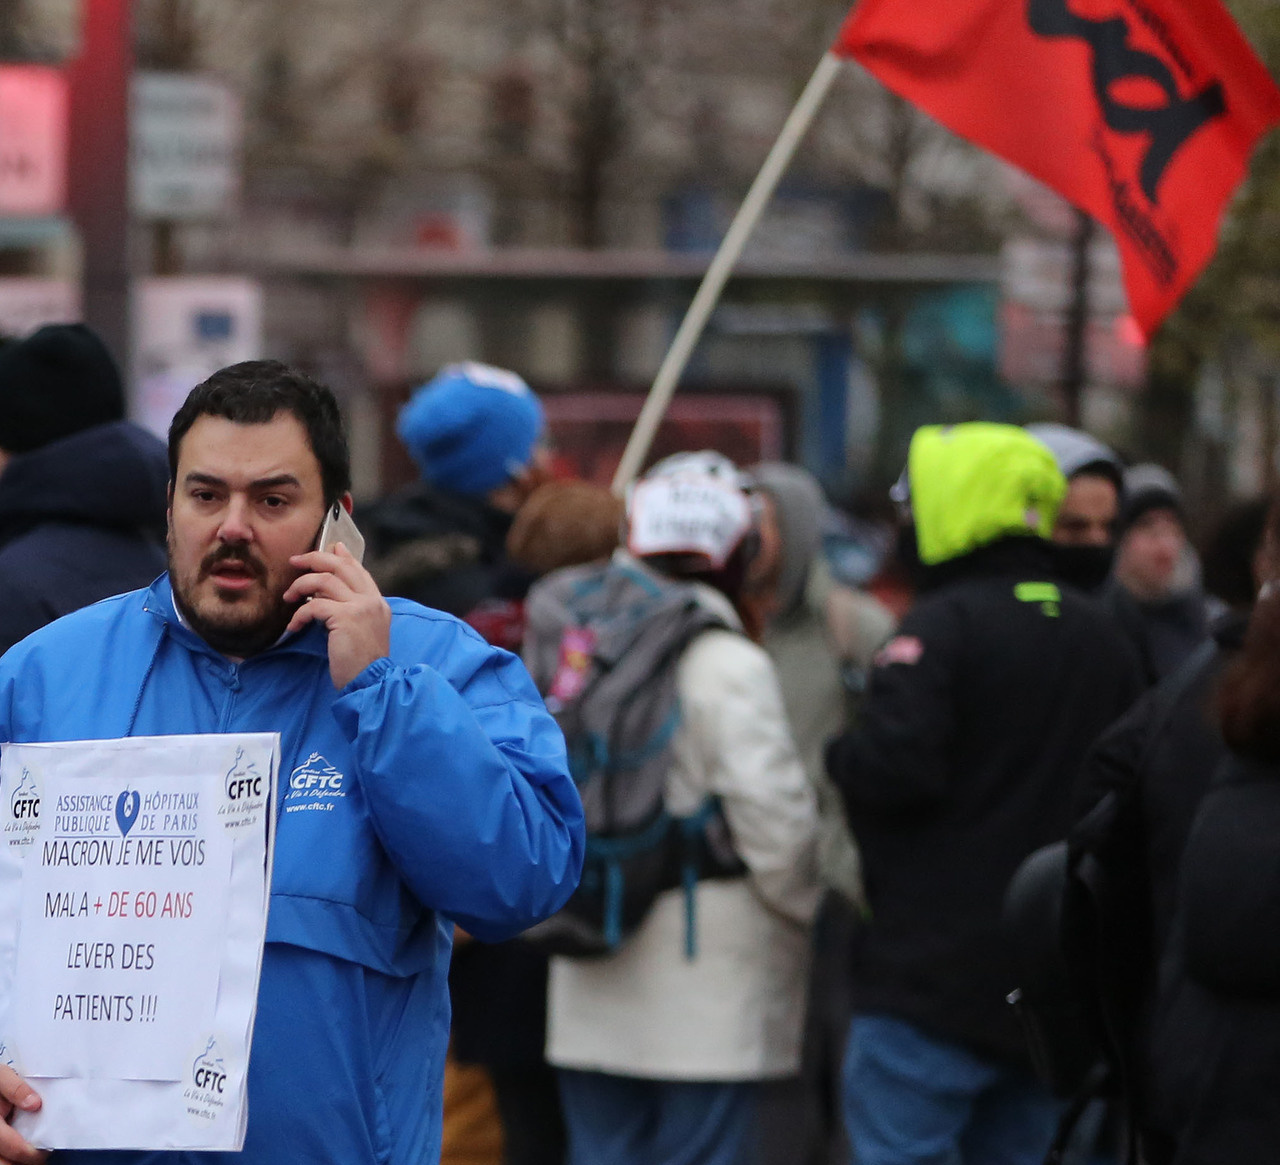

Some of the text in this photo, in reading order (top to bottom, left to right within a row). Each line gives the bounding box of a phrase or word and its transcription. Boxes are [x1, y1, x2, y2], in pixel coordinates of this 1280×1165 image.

[228, 776, 262, 800] CFTC
[293, 774, 343, 789] CFTC
[13, 798, 40, 819] CFTC
[56, 791, 199, 812] ASSISTANCE HÔPITAUX
[286, 802, 335, 813] www.cftc.fr
[54, 813, 198, 834] PUBLIQUE DE PARIS
[42, 839, 205, 867] MACRON JE ME VOIS
[45, 891, 194, 918] MAL A + DE 60 ANS
[67, 942, 155, 970] LEVER DES
[53, 994, 158, 1022] PATIENTS !!!
[195, 1067, 227, 1094] CFTC
